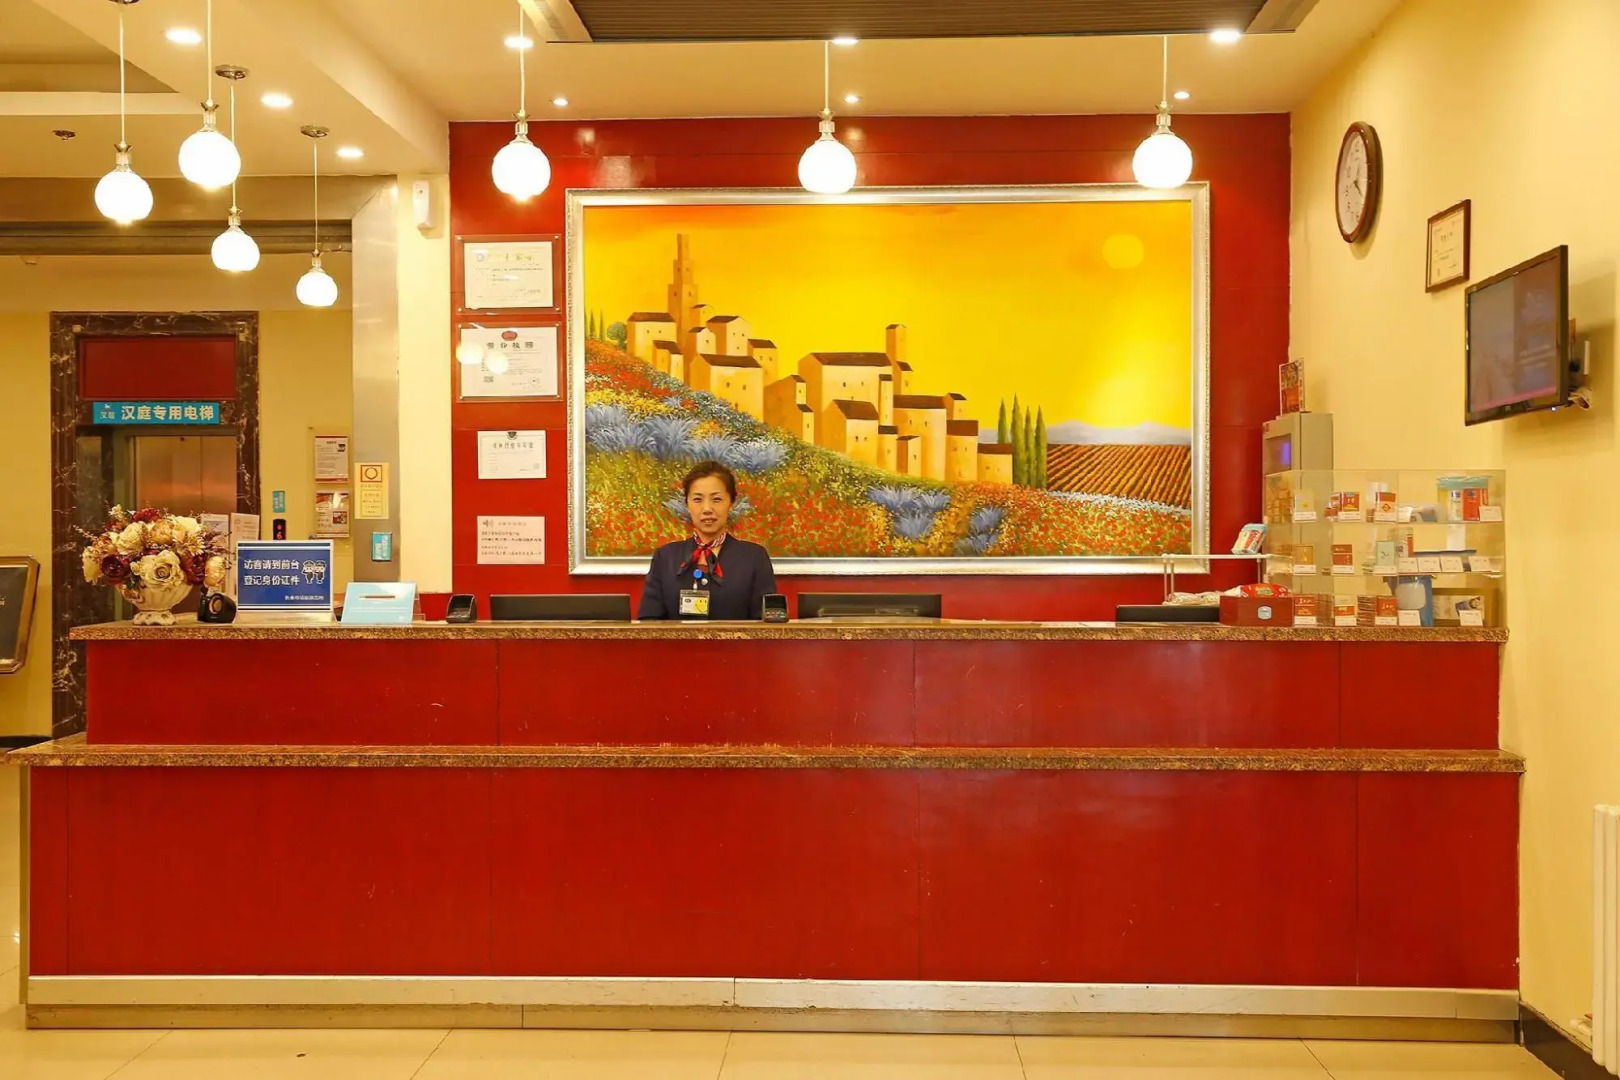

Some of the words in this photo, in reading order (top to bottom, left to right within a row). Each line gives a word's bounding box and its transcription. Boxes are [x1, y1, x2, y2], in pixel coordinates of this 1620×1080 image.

[121, 405, 214, 420] 汉庭专用电梯
[276, 531, 283, 540] 6
[244, 560, 299, 570] 访客请到前台
[244, 575, 300, 586] 登记身份证件
